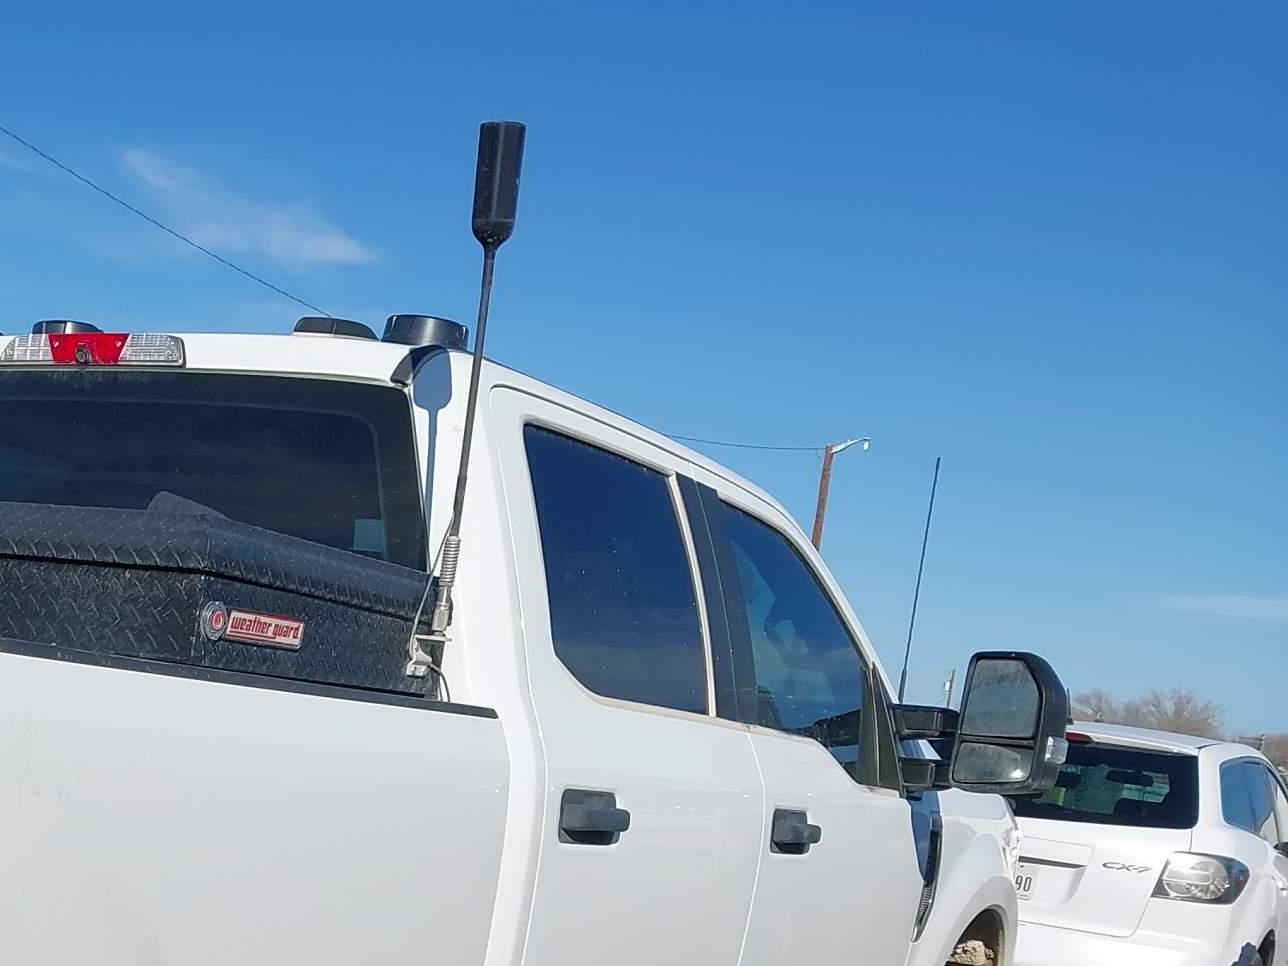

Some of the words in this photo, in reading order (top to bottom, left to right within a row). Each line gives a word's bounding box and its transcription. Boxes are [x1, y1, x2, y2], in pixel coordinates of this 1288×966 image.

[231, 615, 273, 634] weather
[273, 623, 300, 640] guard
[1102, 861, 1152, 873] CX-7
